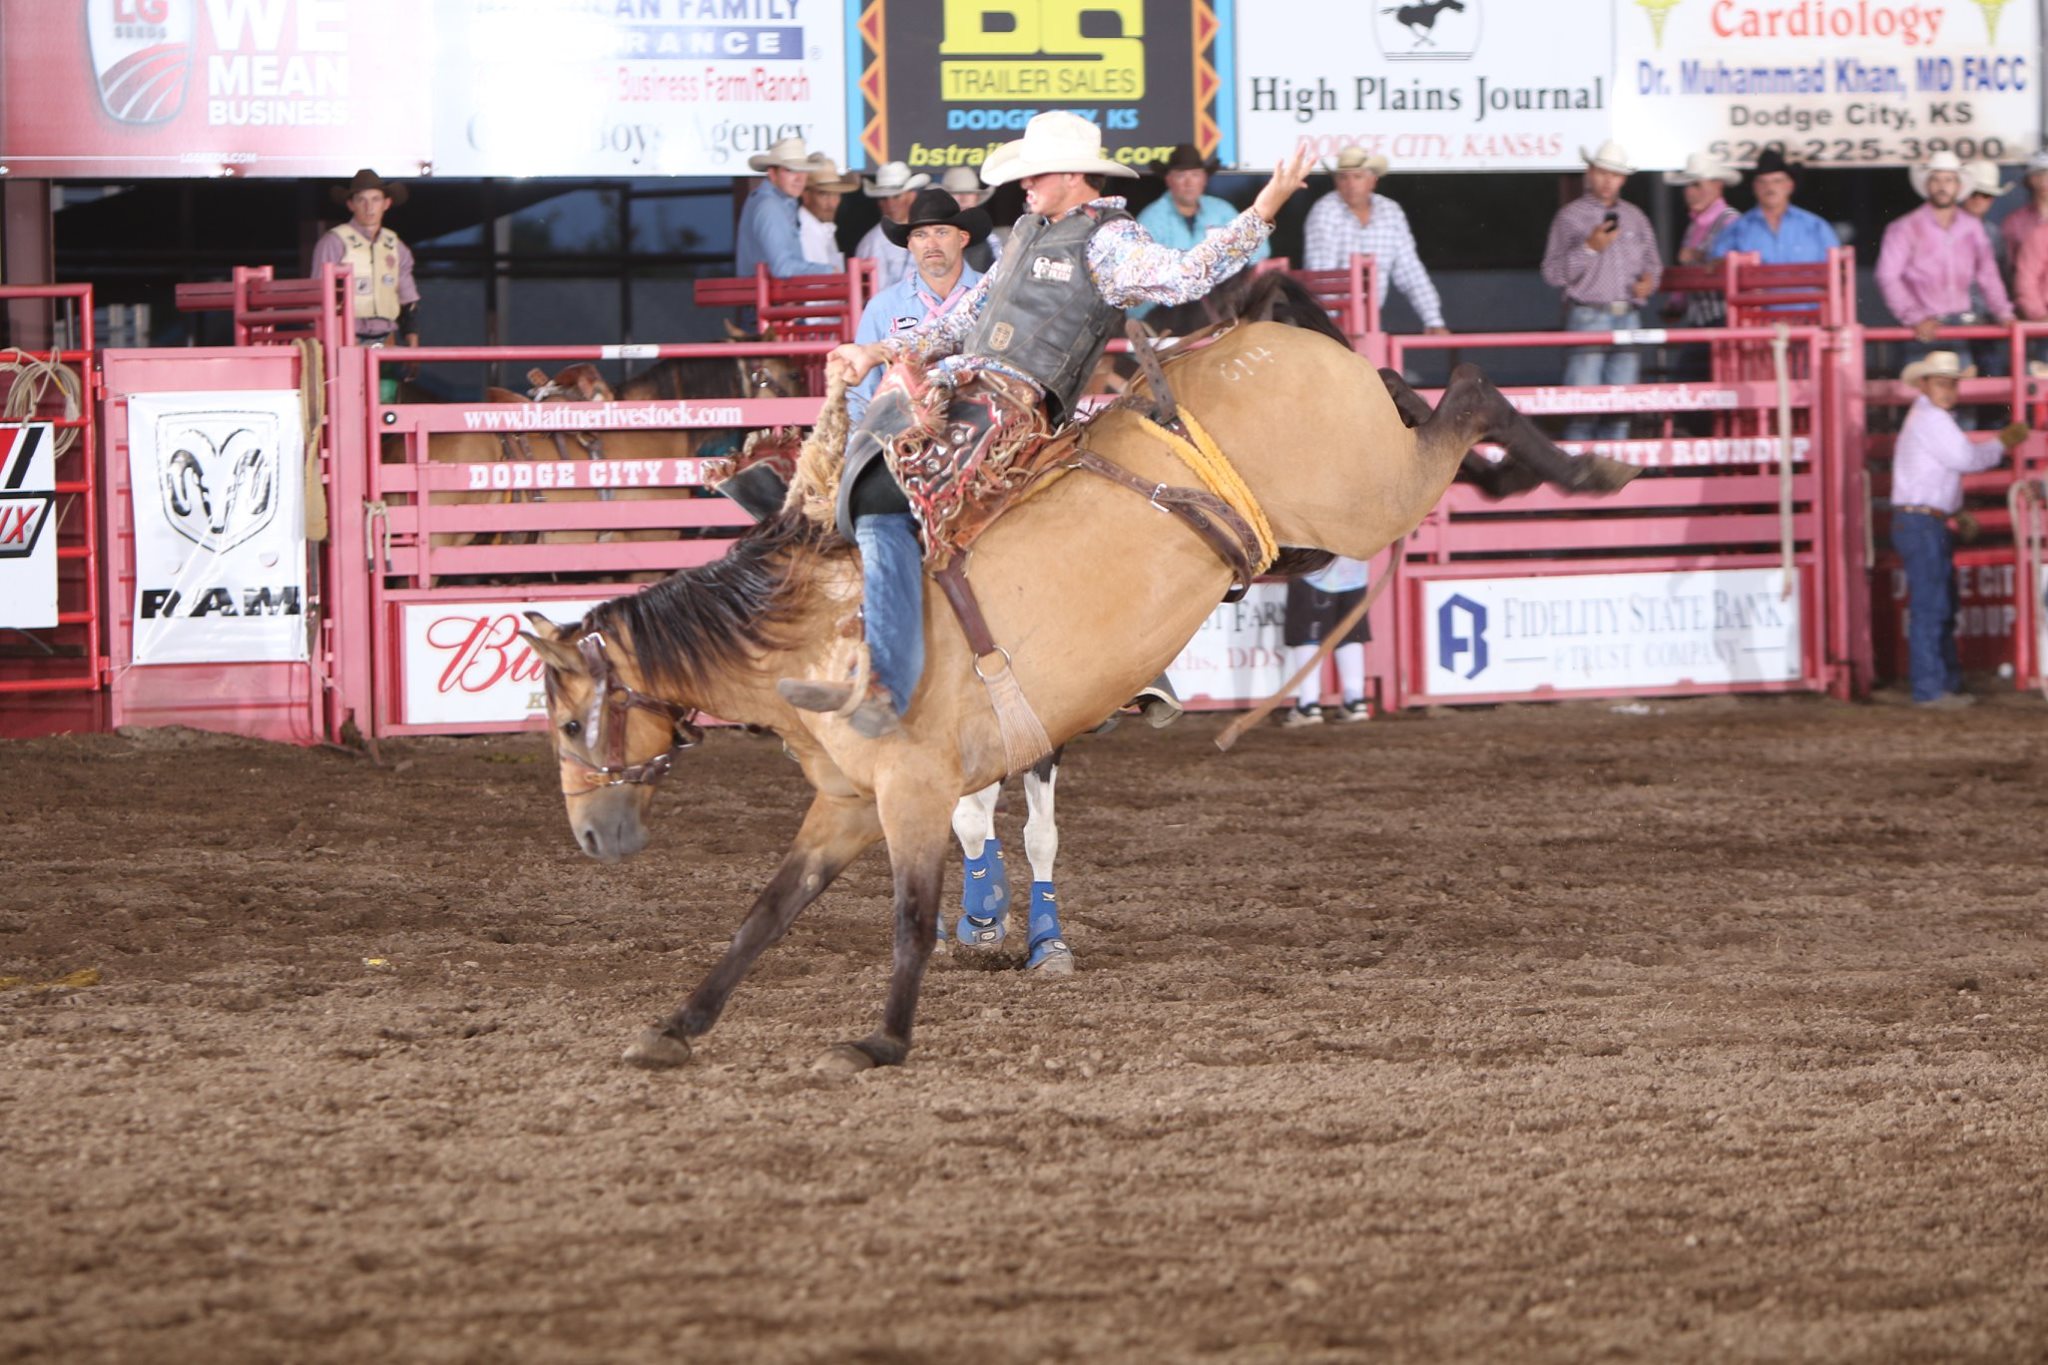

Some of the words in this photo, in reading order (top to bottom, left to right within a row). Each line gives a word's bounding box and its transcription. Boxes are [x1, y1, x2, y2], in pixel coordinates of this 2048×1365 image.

[206, 0, 348, 52] WE
[1709, 0, 1945, 45] Cardiology
[208, 55, 349, 97] MEAN
[950, 68, 1051, 95] TRAILER
[1056, 68, 1137, 95] SALES
[1637, 59, 1670, 95] Dr.
[1680, 58, 1825, 95] Muhammad
[1915, 56, 1954, 92] MD
[1962, 55, 2027, 92] FACC
[1250, 75, 1338, 124] High
[1353, 75, 1463, 112] Plains
[1473, 75, 1605, 123] Journal
[1106, 108, 1140, 131] KS
[1728, 103, 1833, 132] Dodge
[1845, 102, 1917, 131] City,
[1929, 102, 1974, 126] KS
[1460, 131, 1563, 159] KANSAS
[463, 401, 744, 430] www.blattnerlivestock.com
[468, 462, 577, 490] DODGE
[588, 459, 664, 487] CITY
[140, 586, 302, 619] RAM
[1502, 596, 1623, 640] FIDELITY
[1630, 591, 1709, 634] STATE
[1713, 588, 1788, 631] BANK
